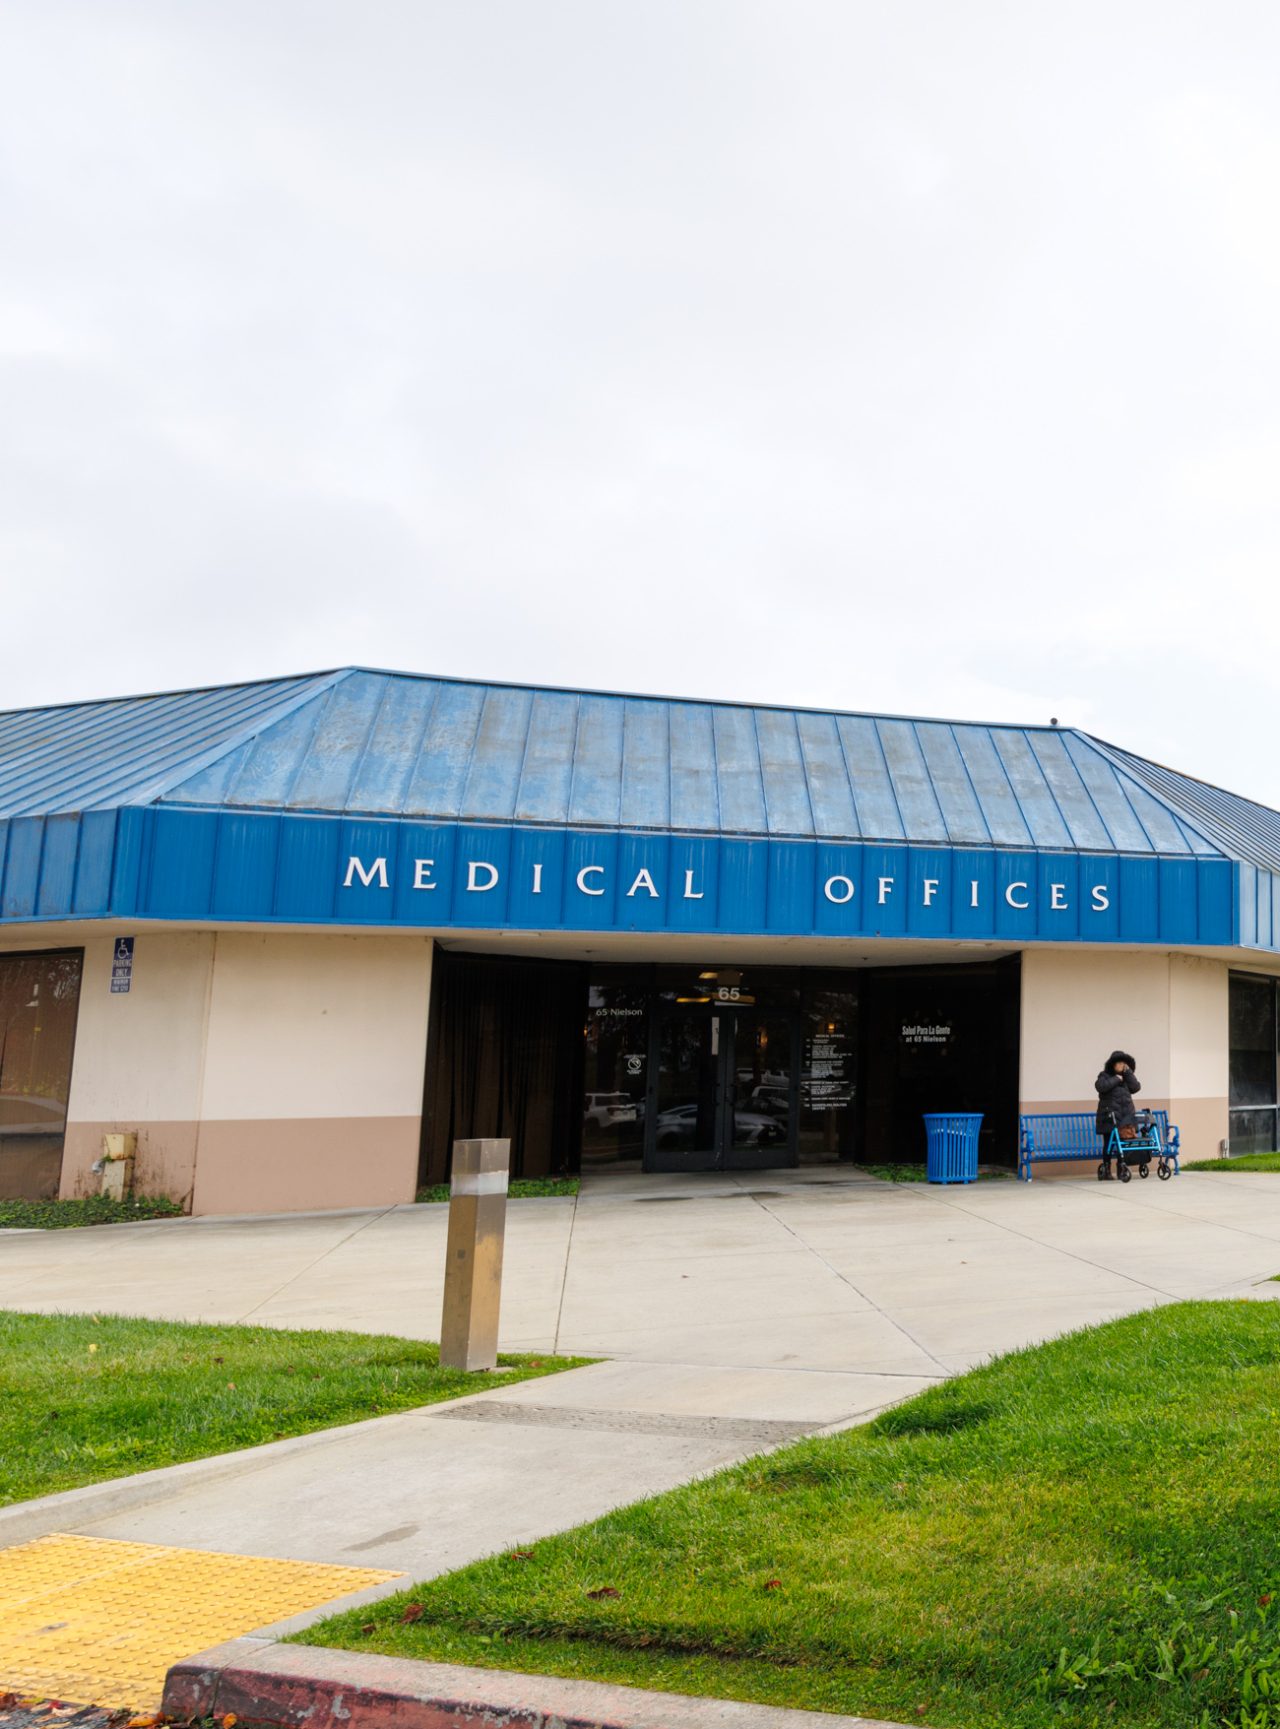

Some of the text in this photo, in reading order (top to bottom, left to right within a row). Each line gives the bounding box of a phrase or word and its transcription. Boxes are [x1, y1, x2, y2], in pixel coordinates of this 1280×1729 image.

[343, 856, 1109, 911] MEDICAL OFFICES
[718, 987, 740, 1000] 65
[611, 1008, 643, 1016] Nielson
